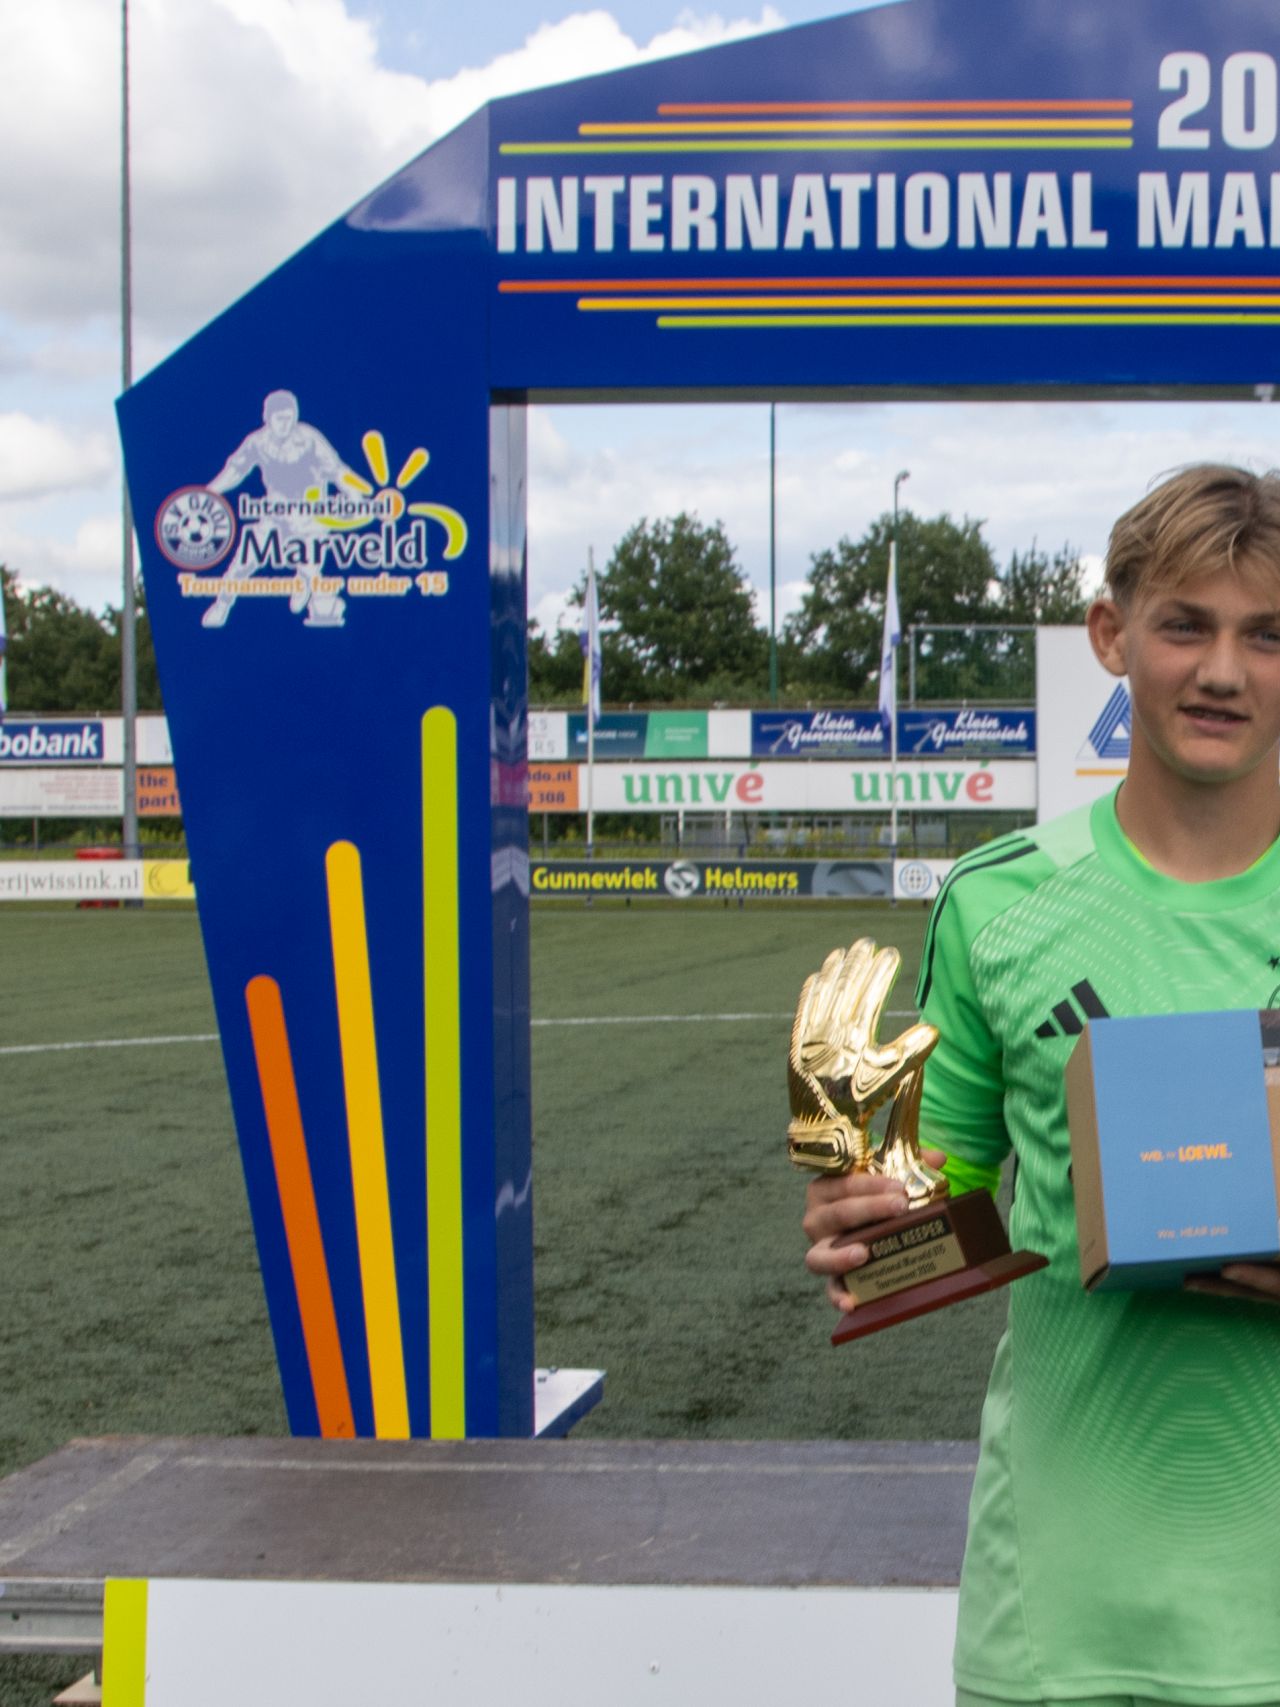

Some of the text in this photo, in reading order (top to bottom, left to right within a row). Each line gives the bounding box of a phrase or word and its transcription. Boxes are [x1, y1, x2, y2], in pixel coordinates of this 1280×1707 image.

[496, 172, 1108, 254] INTERNATIONAL
[239, 493, 394, 519] International
[241, 520, 426, 568] Marveld
[179, 572, 449, 596] Tournament for under 15
[810, 711, 855, 731] Klein
[954, 710, 999, 730] Klein
[787, 722, 884, 750] Gunnewiek
[932, 721, 1028, 750] Gunnewiek
[139, 775, 168, 788] the
[622, 762, 764, 804] univé
[850, 760, 994, 803] univé
[532, 866, 799, 891] Gunnewiek Helmers
